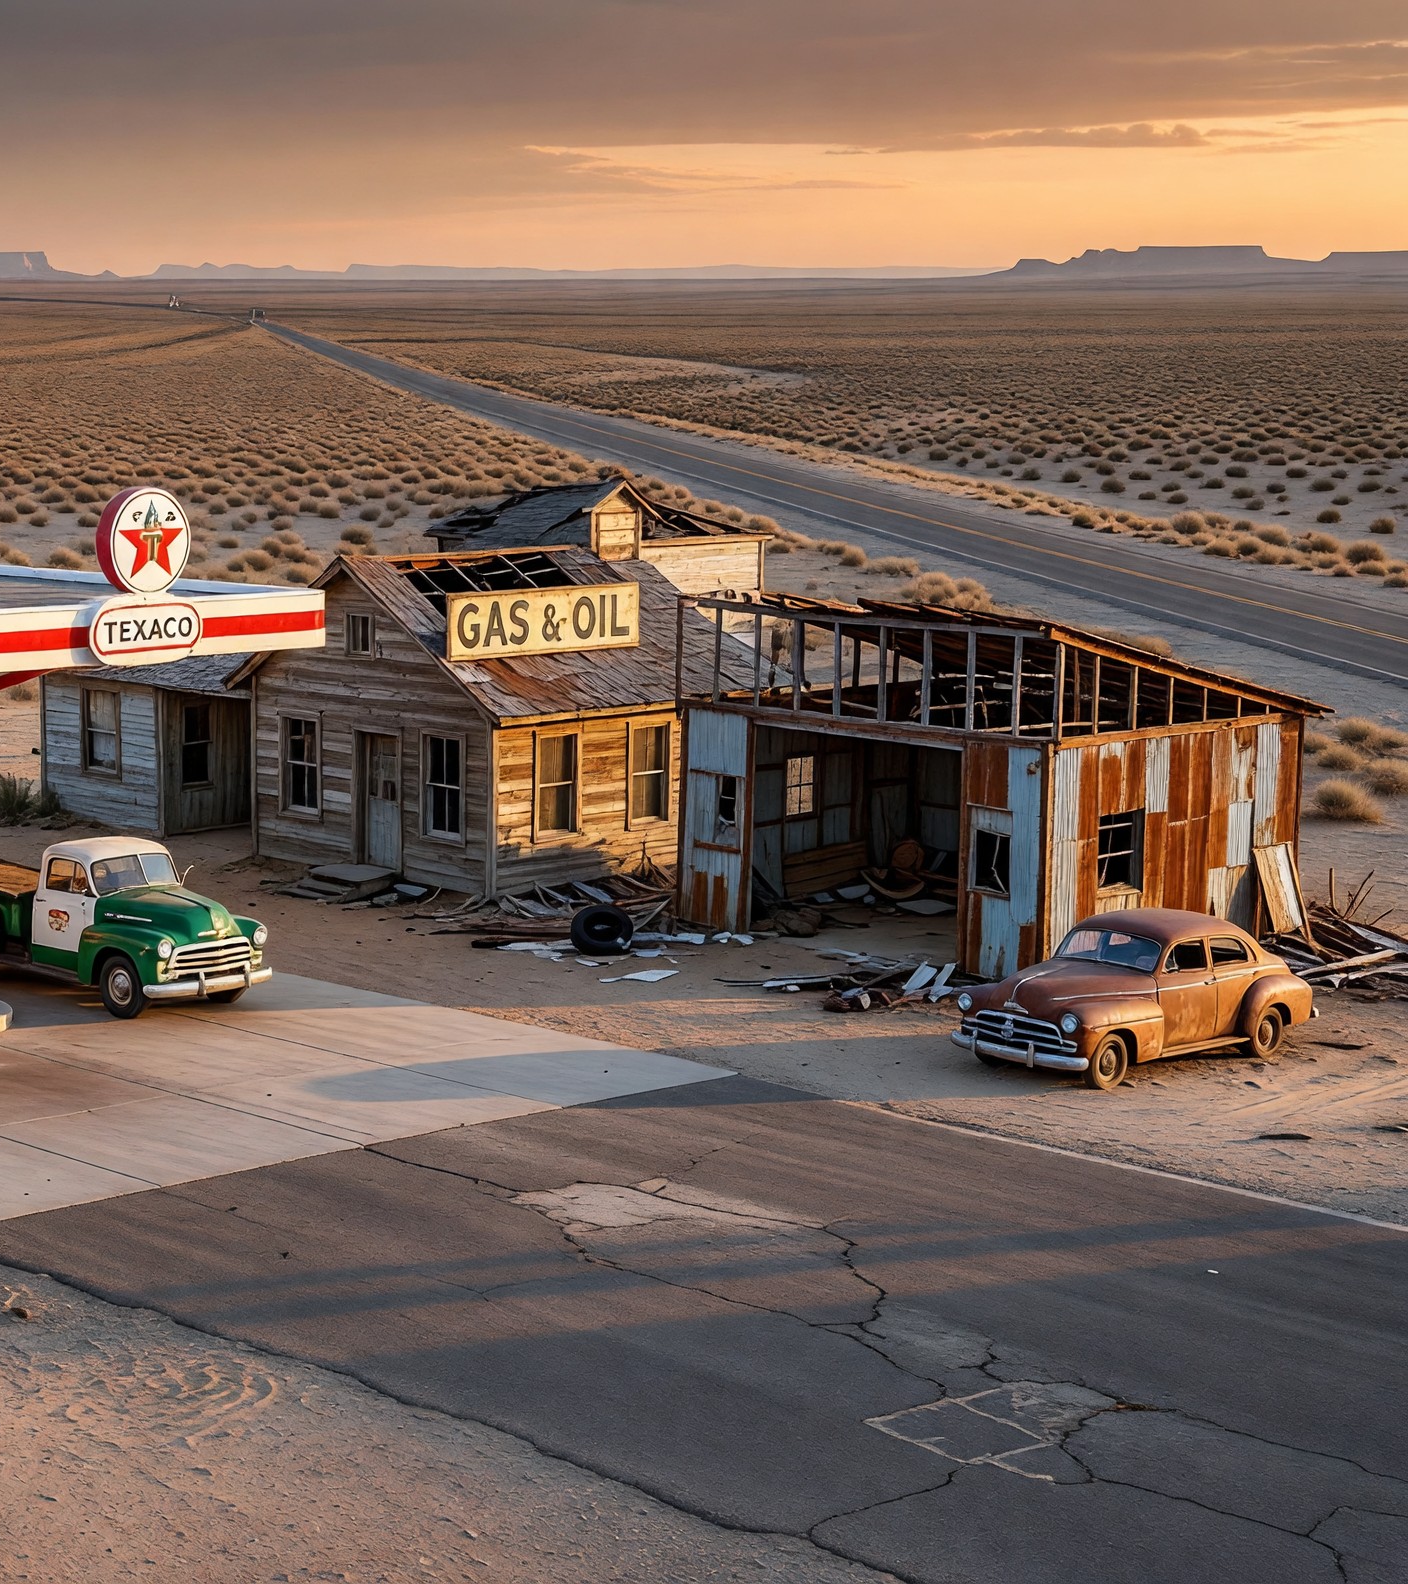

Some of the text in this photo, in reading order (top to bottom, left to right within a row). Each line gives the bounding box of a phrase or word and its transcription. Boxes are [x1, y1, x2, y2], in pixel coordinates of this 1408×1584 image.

[103, 616, 193, 645] TEXACO
[457, 594, 630, 650] GAS & OIL
